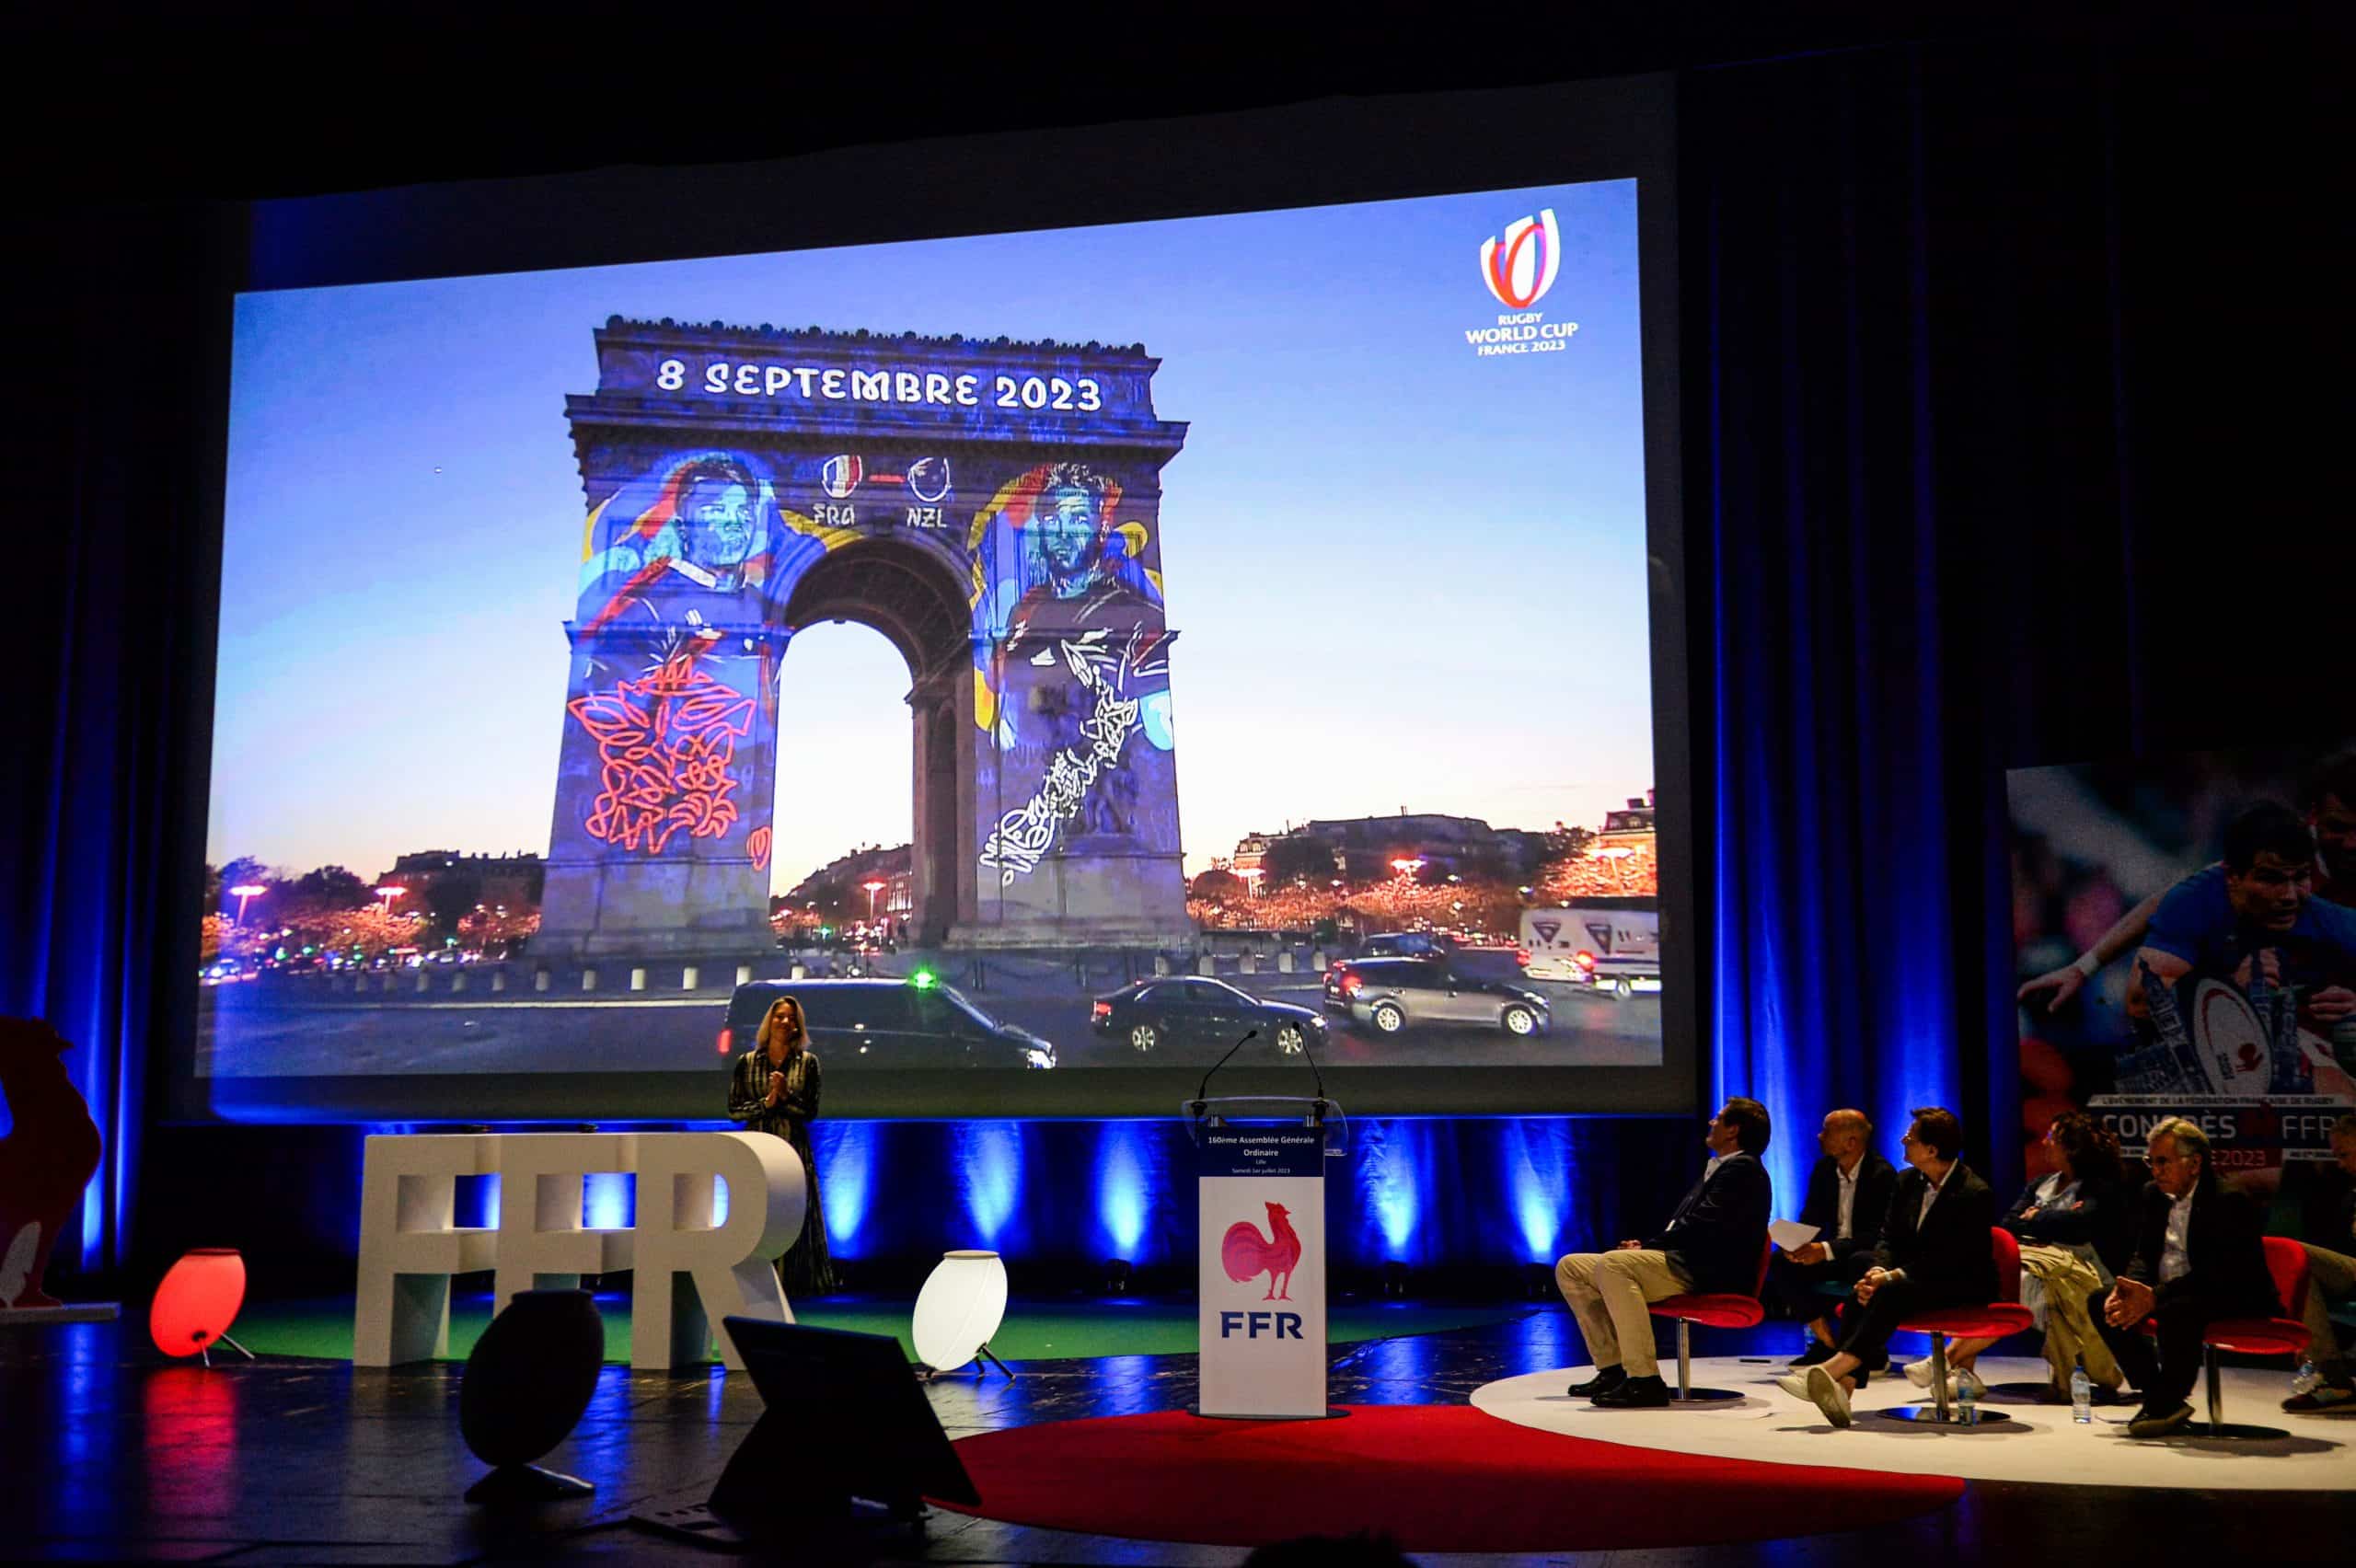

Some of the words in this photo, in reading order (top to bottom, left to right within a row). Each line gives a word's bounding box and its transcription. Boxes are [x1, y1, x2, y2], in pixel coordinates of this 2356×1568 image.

[1497, 312, 1543, 325] RUGBY
[1465, 325, 1537, 344] WORLD
[1541, 322, 1578, 338] CUP
[1477, 343, 1529, 356] FRANCE
[1530, 340, 1565, 352] 2023
[655, 359, 684, 391] 8
[704, 362, 979, 406] SEPTEMBRE
[996, 376, 1102, 411] 2023
[813, 503, 855, 525] FRA
[907, 507, 947, 528] NZL
[1239, 1136, 1279, 1144] Assemblée
[1280, 1136, 1315, 1144] Générale
[1243, 1148, 1279, 1157] Ordinaire
[353, 1132, 806, 1370] FFR
[1219, 1311, 1304, 1340] FFR
